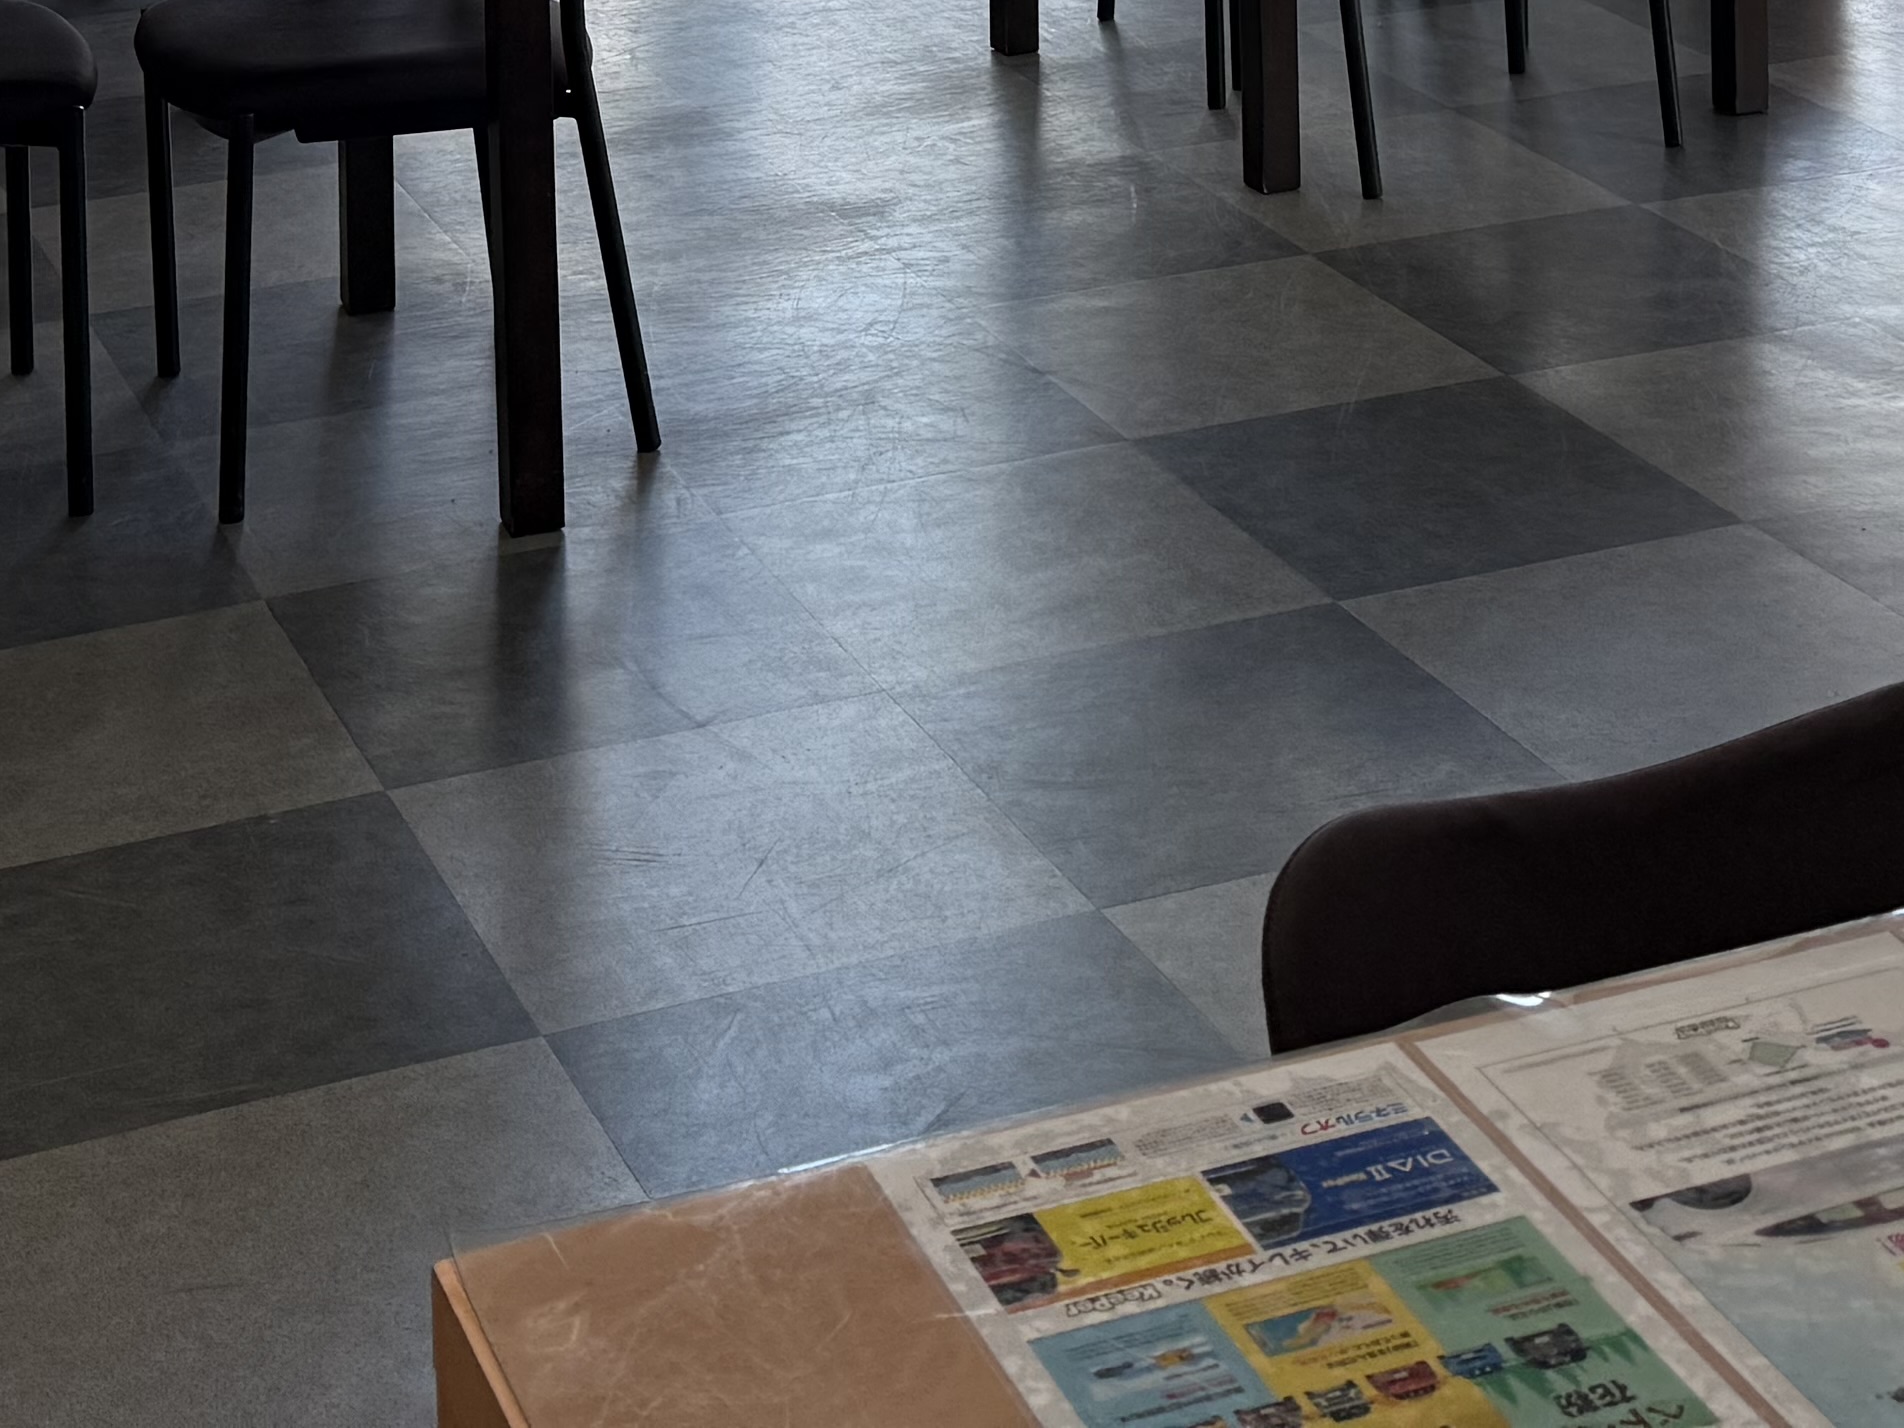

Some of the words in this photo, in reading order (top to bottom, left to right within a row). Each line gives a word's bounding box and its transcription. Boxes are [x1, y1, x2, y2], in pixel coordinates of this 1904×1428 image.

[1160, 1206, 1462, 1296] 汚れを弾いて、キレイが続く。
[1065, 1281, 1160, 1318] KeePer
